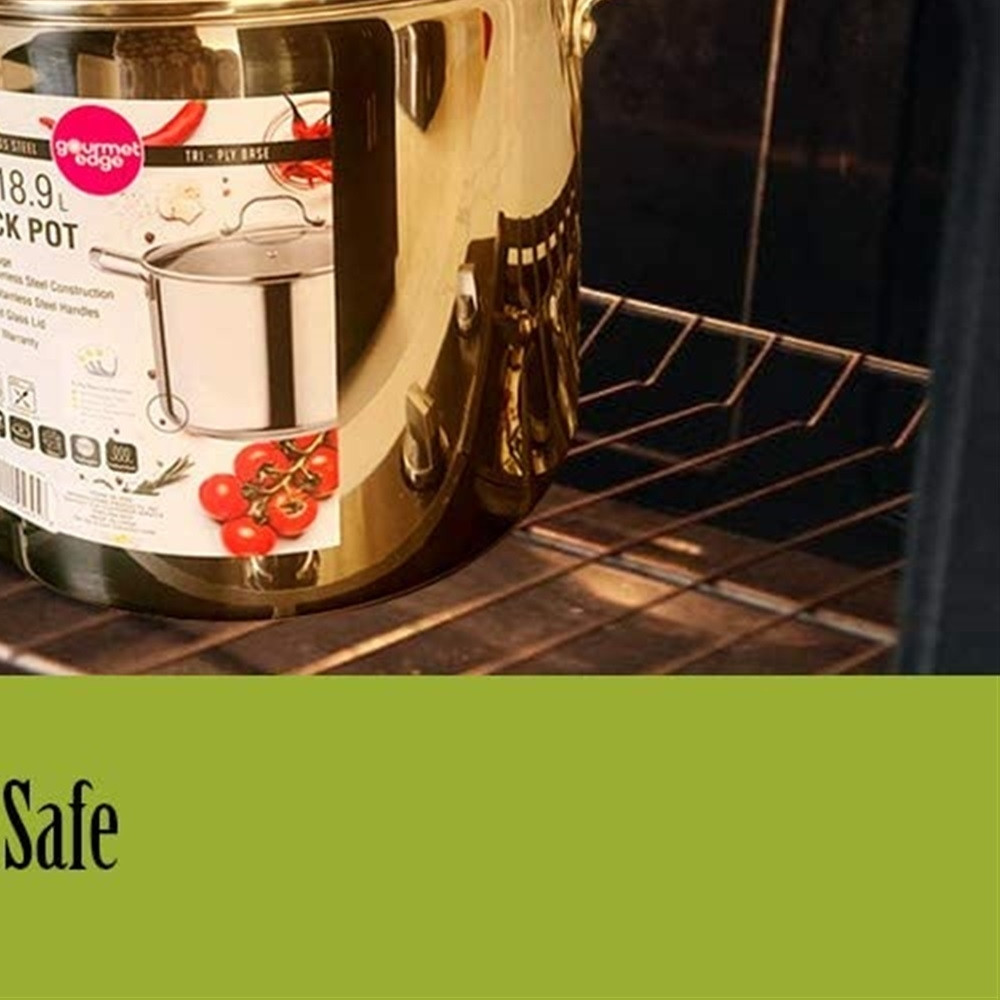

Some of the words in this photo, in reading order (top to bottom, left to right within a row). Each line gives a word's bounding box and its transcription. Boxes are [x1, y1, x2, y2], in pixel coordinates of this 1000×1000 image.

[10, 139, 38, 157] STEEL
[55, 138, 140, 157] gourmet
[185, 149, 204, 163] TRI
[217, 147, 236, 162] PLY
[240, 145, 270, 161] BASE
[75, 151, 124, 172] edge
[27, 217, 78, 249] POT
[25, 274, 48, 289] Steel
[50, 279, 115, 300] Construction
[33, 296, 58, 312] Steel
[59, 302, 101, 319] Handles
